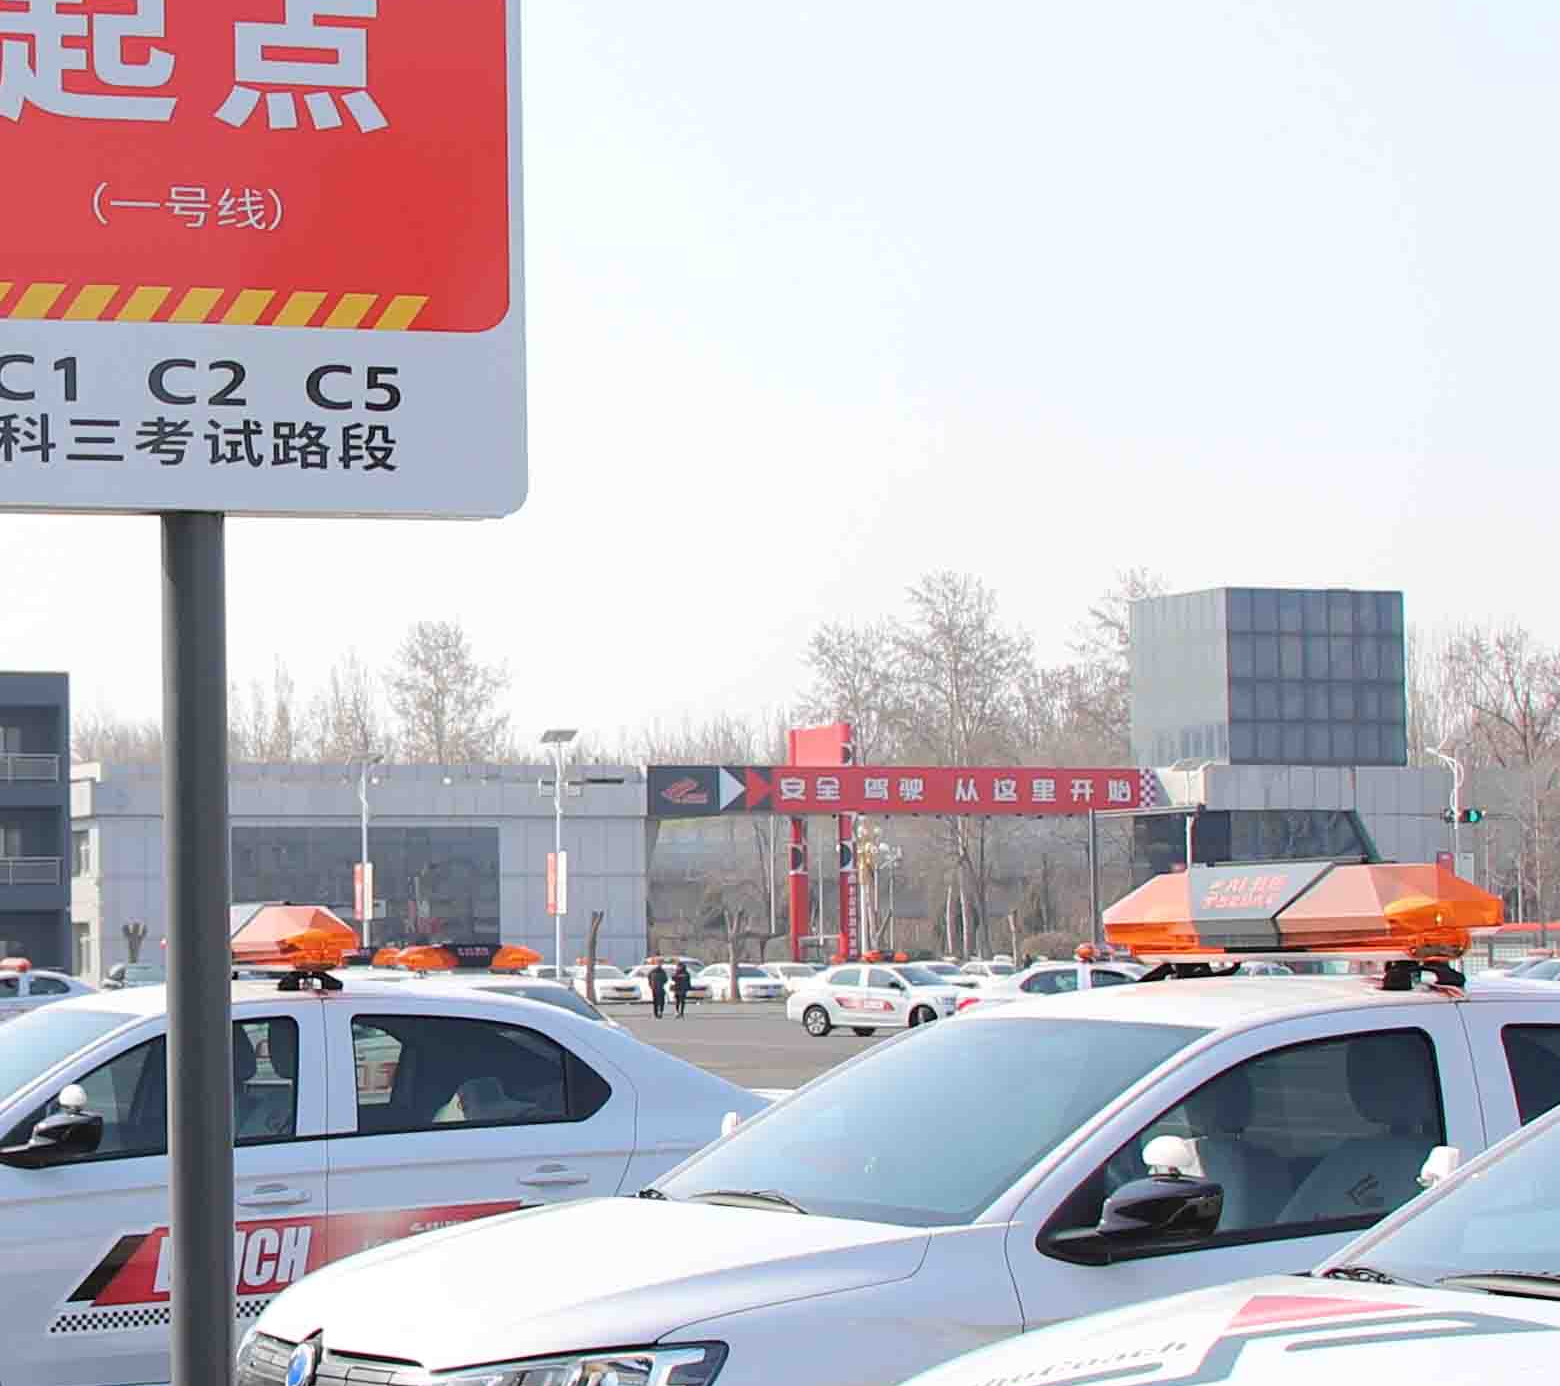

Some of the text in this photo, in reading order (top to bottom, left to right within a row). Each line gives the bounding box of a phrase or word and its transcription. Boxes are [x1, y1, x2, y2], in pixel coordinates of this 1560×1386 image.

[148, 358, 248, 408] C2
[306, 363, 402, 413] C5
[780, 776, 1133, 804] 安全 驾驶 从这里开始
[152, 1226, 312, 1294] LCH
